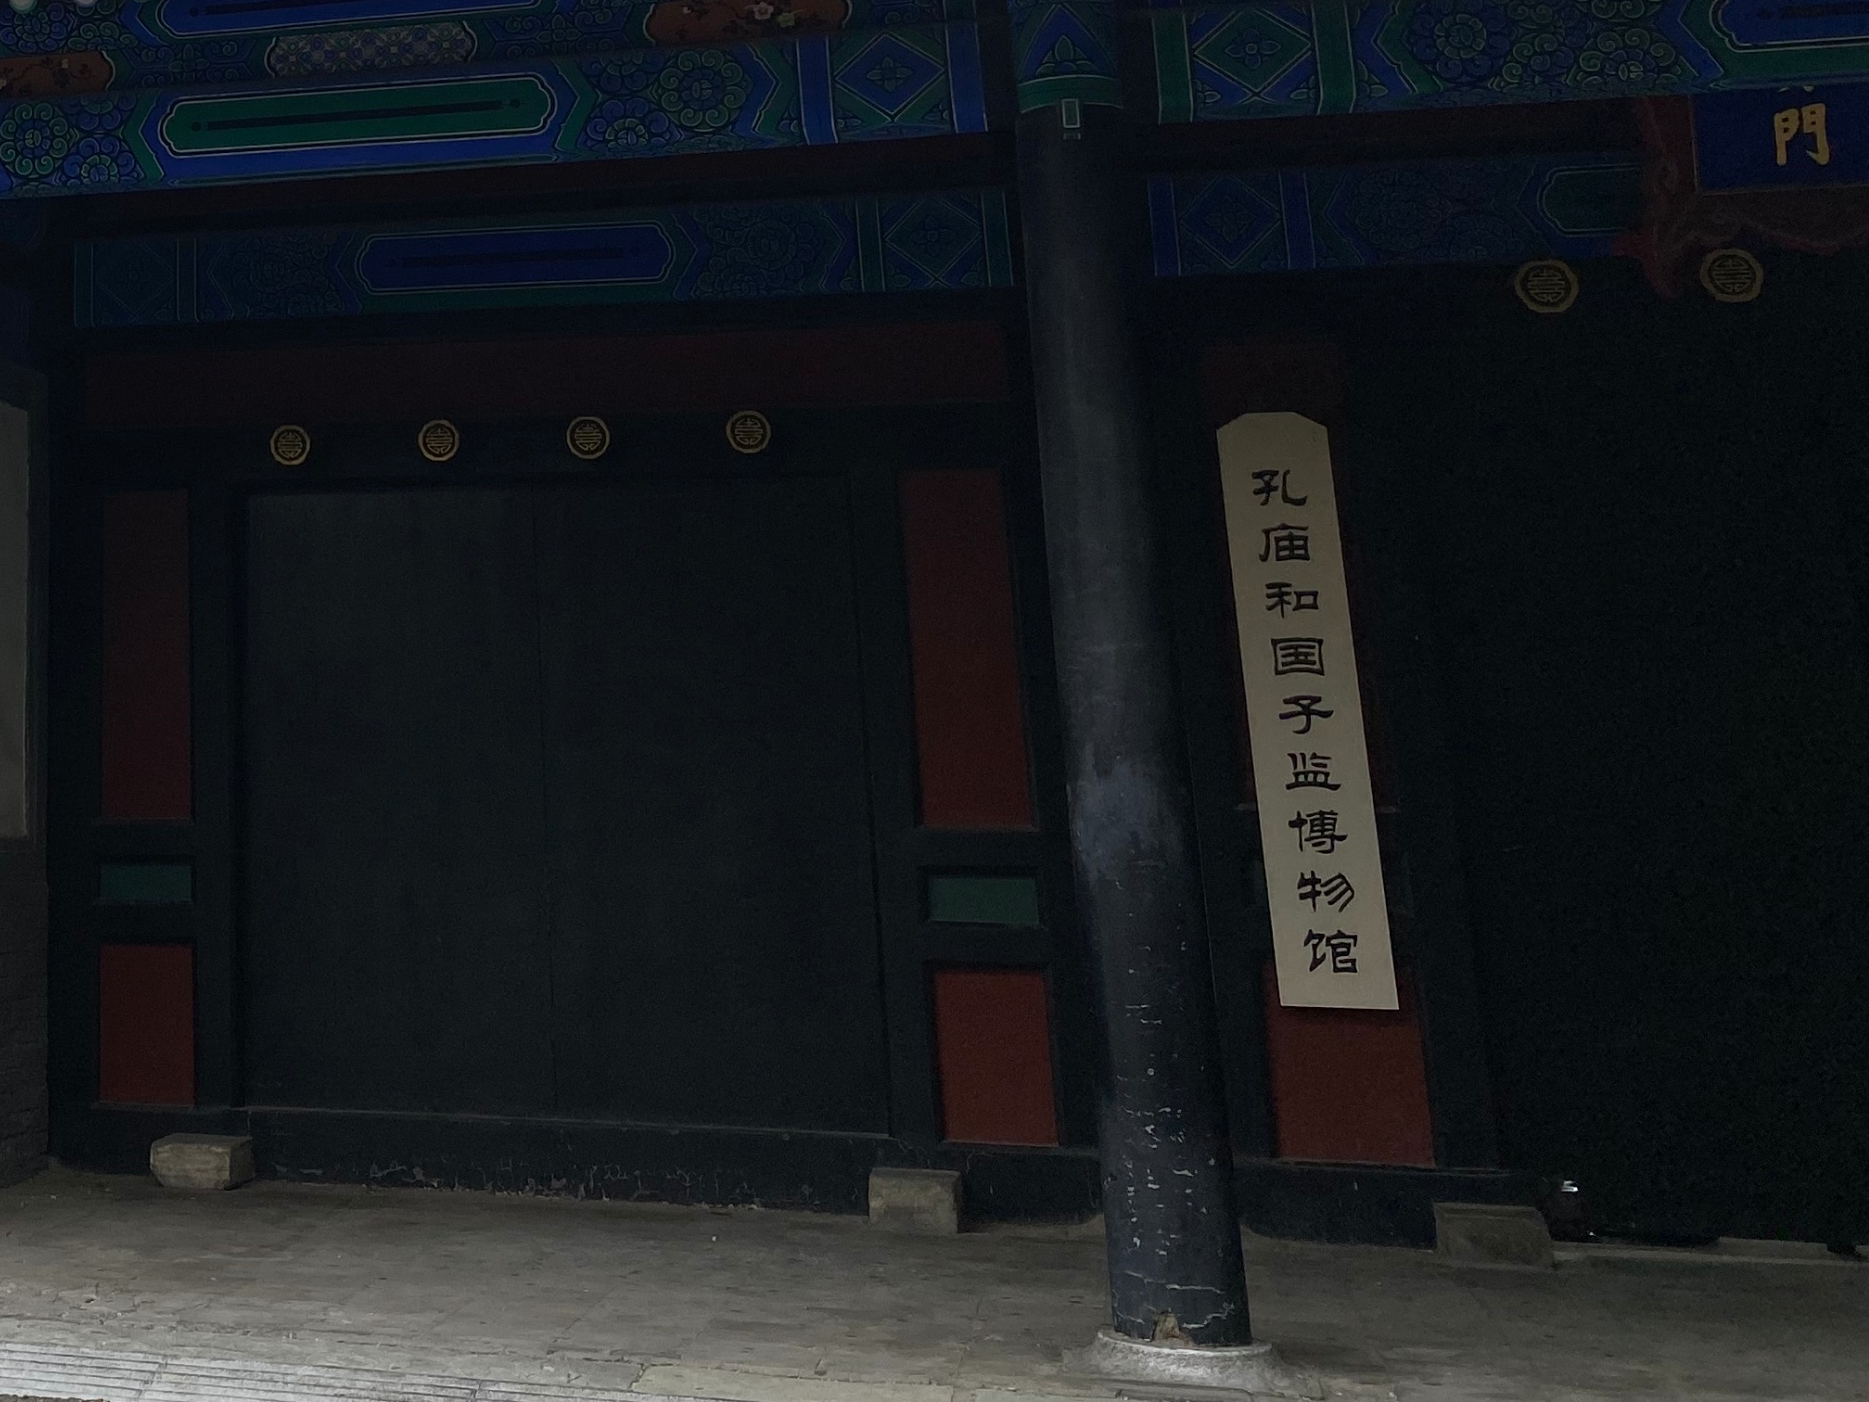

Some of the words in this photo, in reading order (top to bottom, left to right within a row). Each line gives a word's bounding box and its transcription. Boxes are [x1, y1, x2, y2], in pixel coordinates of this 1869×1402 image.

[1773, 85, 1830, 165] 門
[1251, 468, 1359, 974] 孔庙和国子监博物馆
